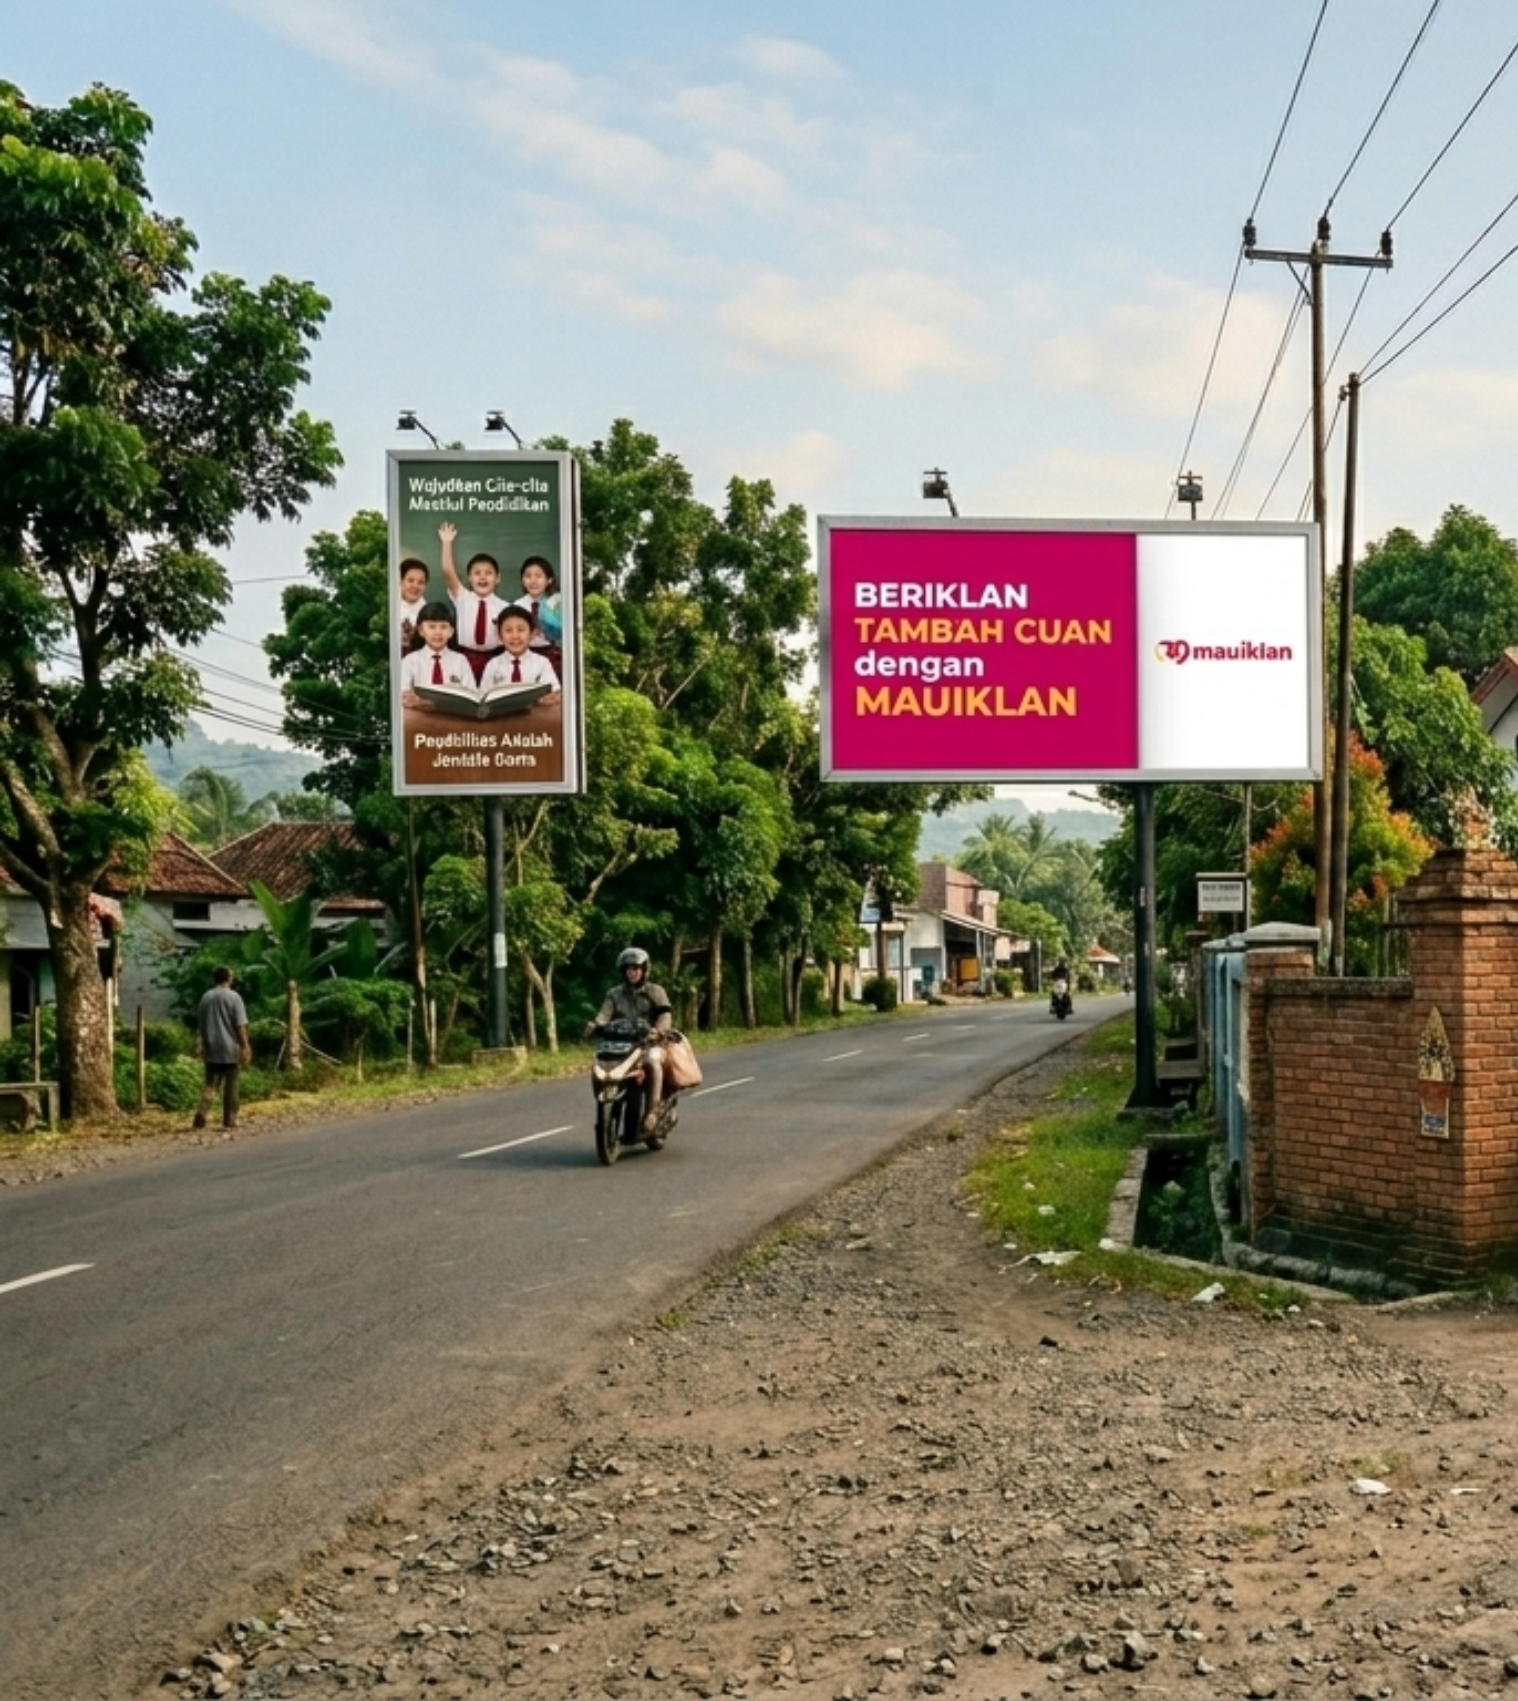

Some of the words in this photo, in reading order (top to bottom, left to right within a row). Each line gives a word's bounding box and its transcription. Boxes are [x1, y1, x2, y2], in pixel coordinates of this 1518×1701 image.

[855, 582, 1028, 608] BERIKLAN
[854, 617, 1003, 643] TAMBAH
[1014, 618, 1112, 644] CUAN
[1193, 640, 1292, 660] mauiklan
[854, 650, 984, 682] dengan
[856, 686, 1077, 716] MAUIKLAN
